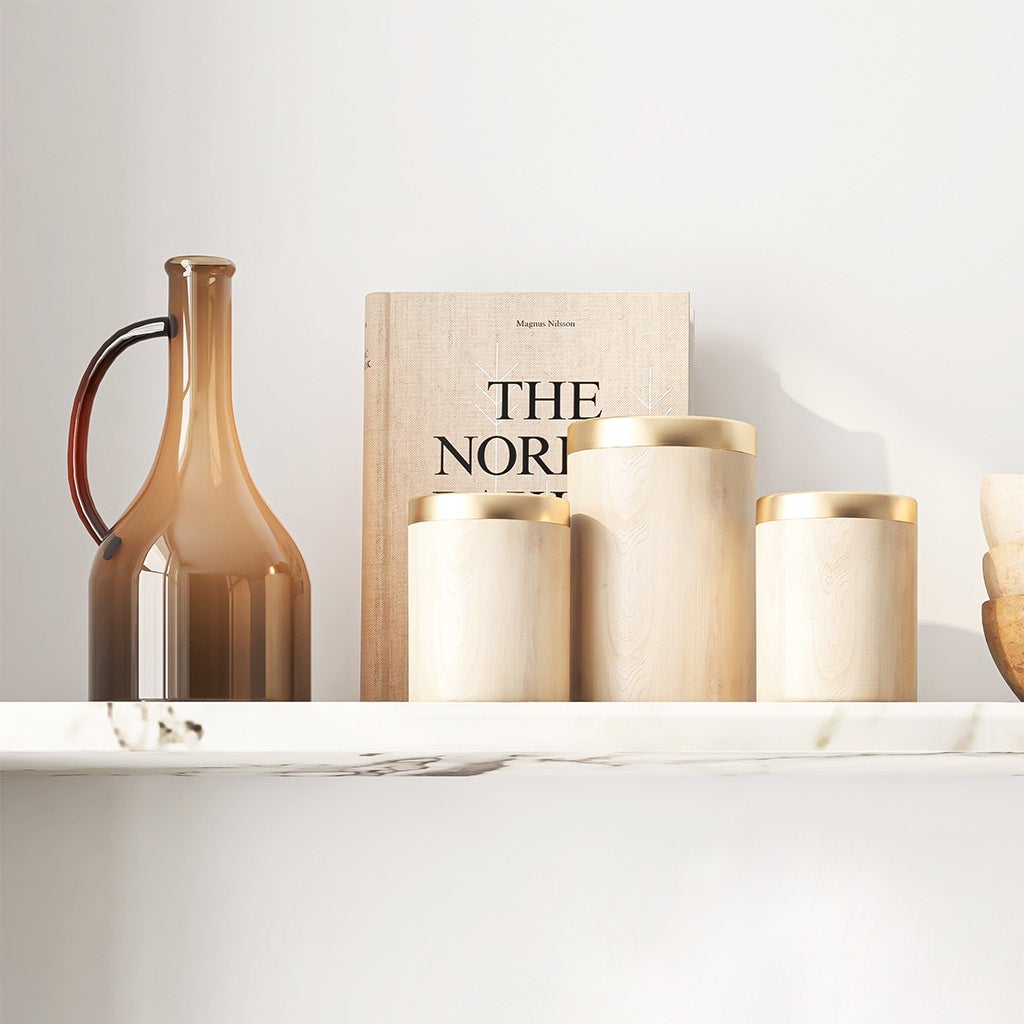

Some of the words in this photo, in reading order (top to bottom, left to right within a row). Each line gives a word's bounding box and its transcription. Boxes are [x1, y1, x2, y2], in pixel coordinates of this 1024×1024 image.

[516, 319, 546, 330] Magnus
[548, 319, 576, 328] Nilsson
[487, 381, 603, 420] THE
